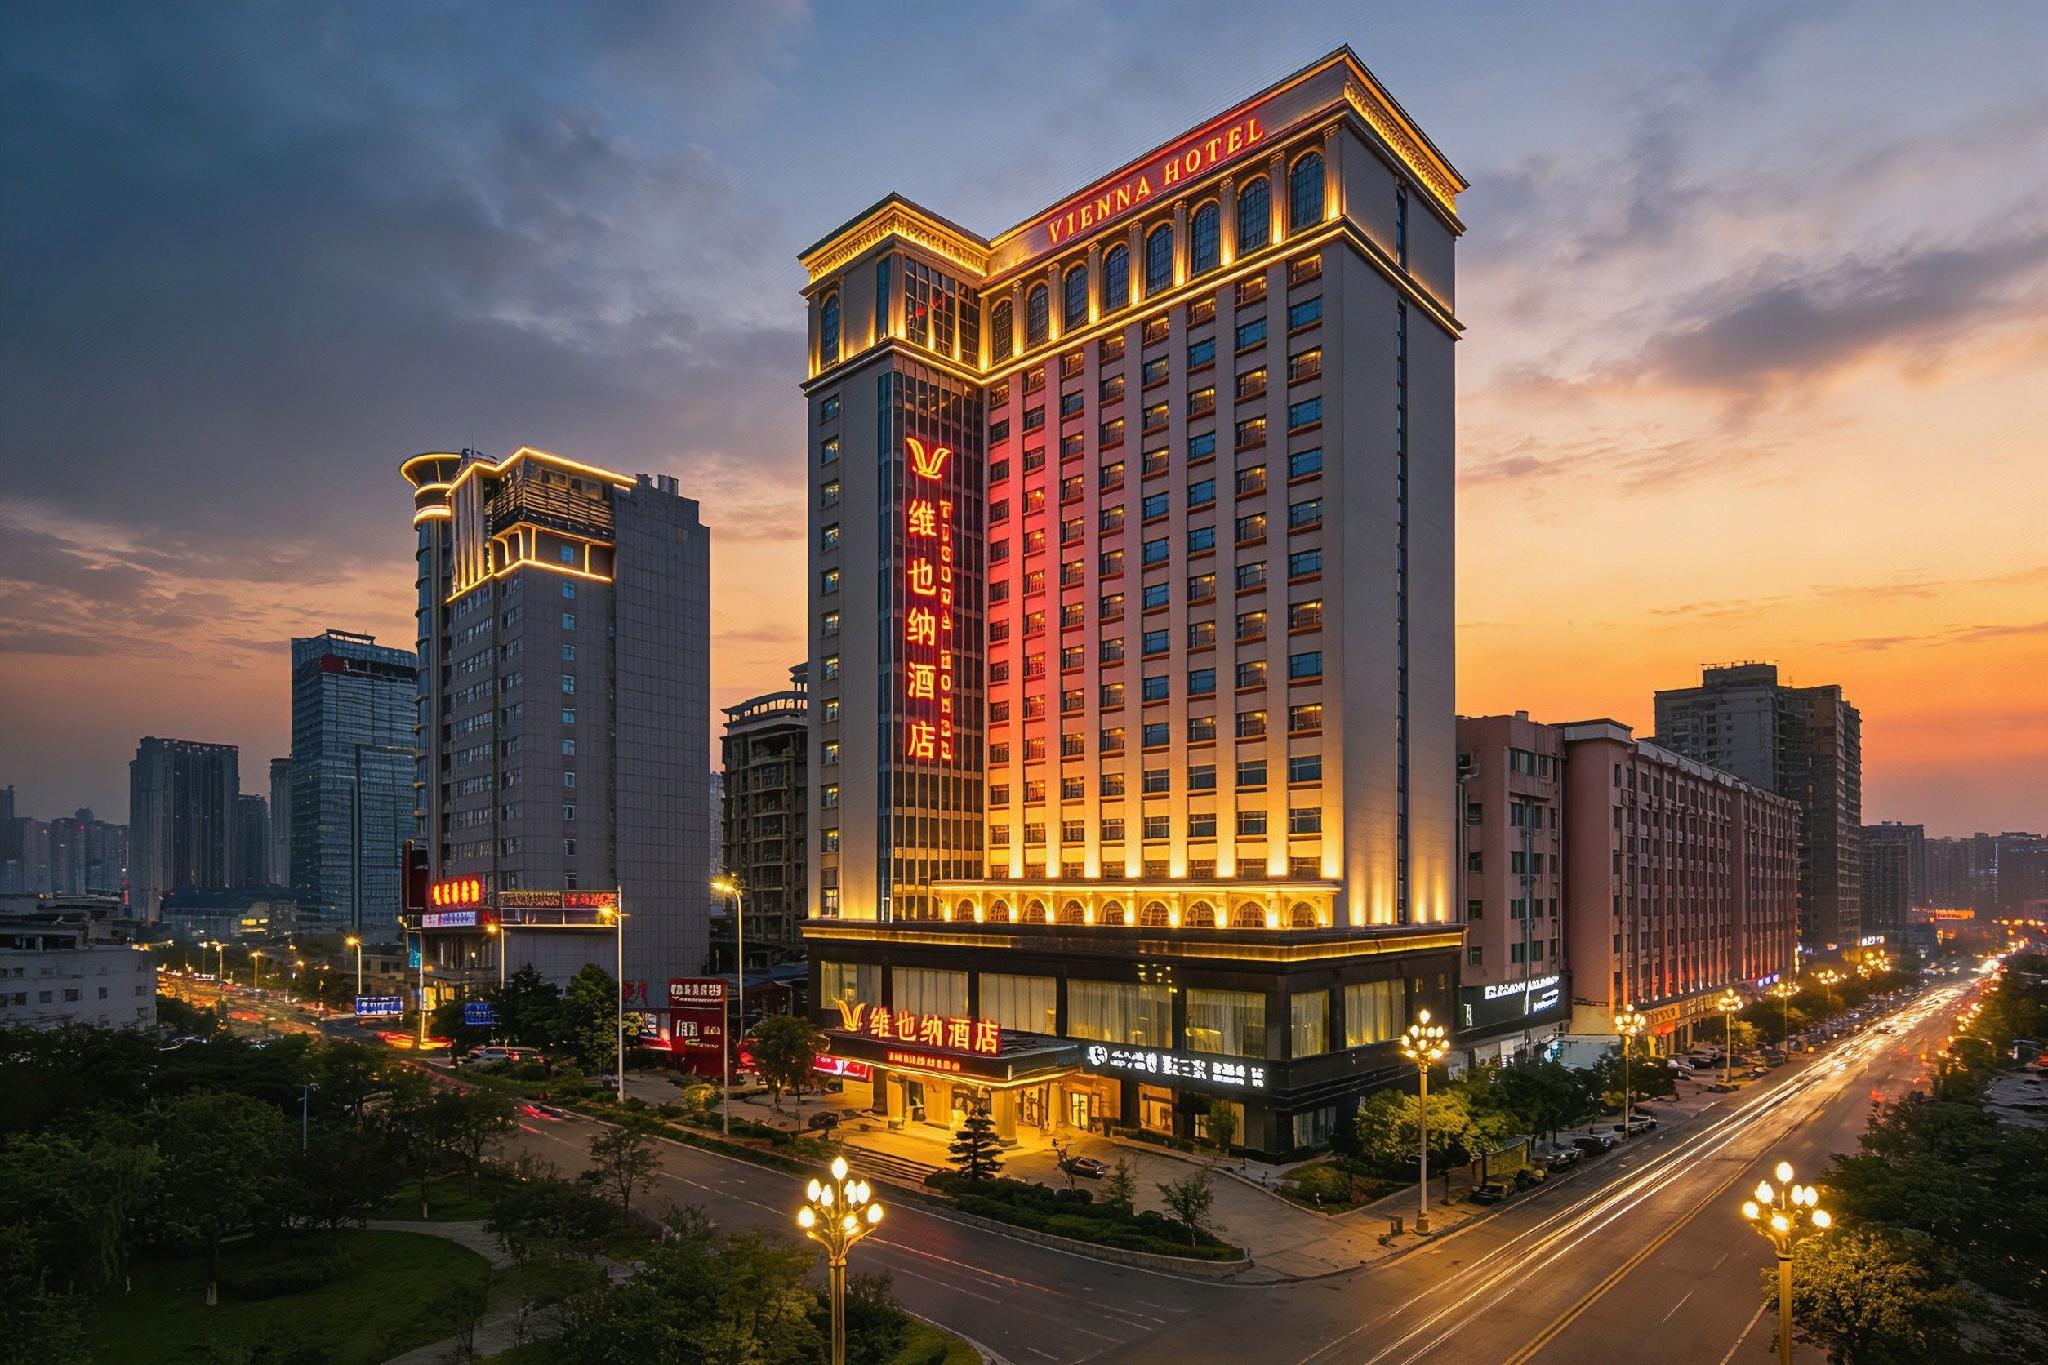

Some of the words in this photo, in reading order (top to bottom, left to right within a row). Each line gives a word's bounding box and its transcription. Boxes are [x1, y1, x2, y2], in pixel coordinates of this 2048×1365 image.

[1048, 175, 1152, 244] VIENNA
[1163, 119, 1264, 186] HOTEL
[907, 499, 937, 759] 维也纳酒店
[869, 1007, 999, 1054] 维也纳酒店
